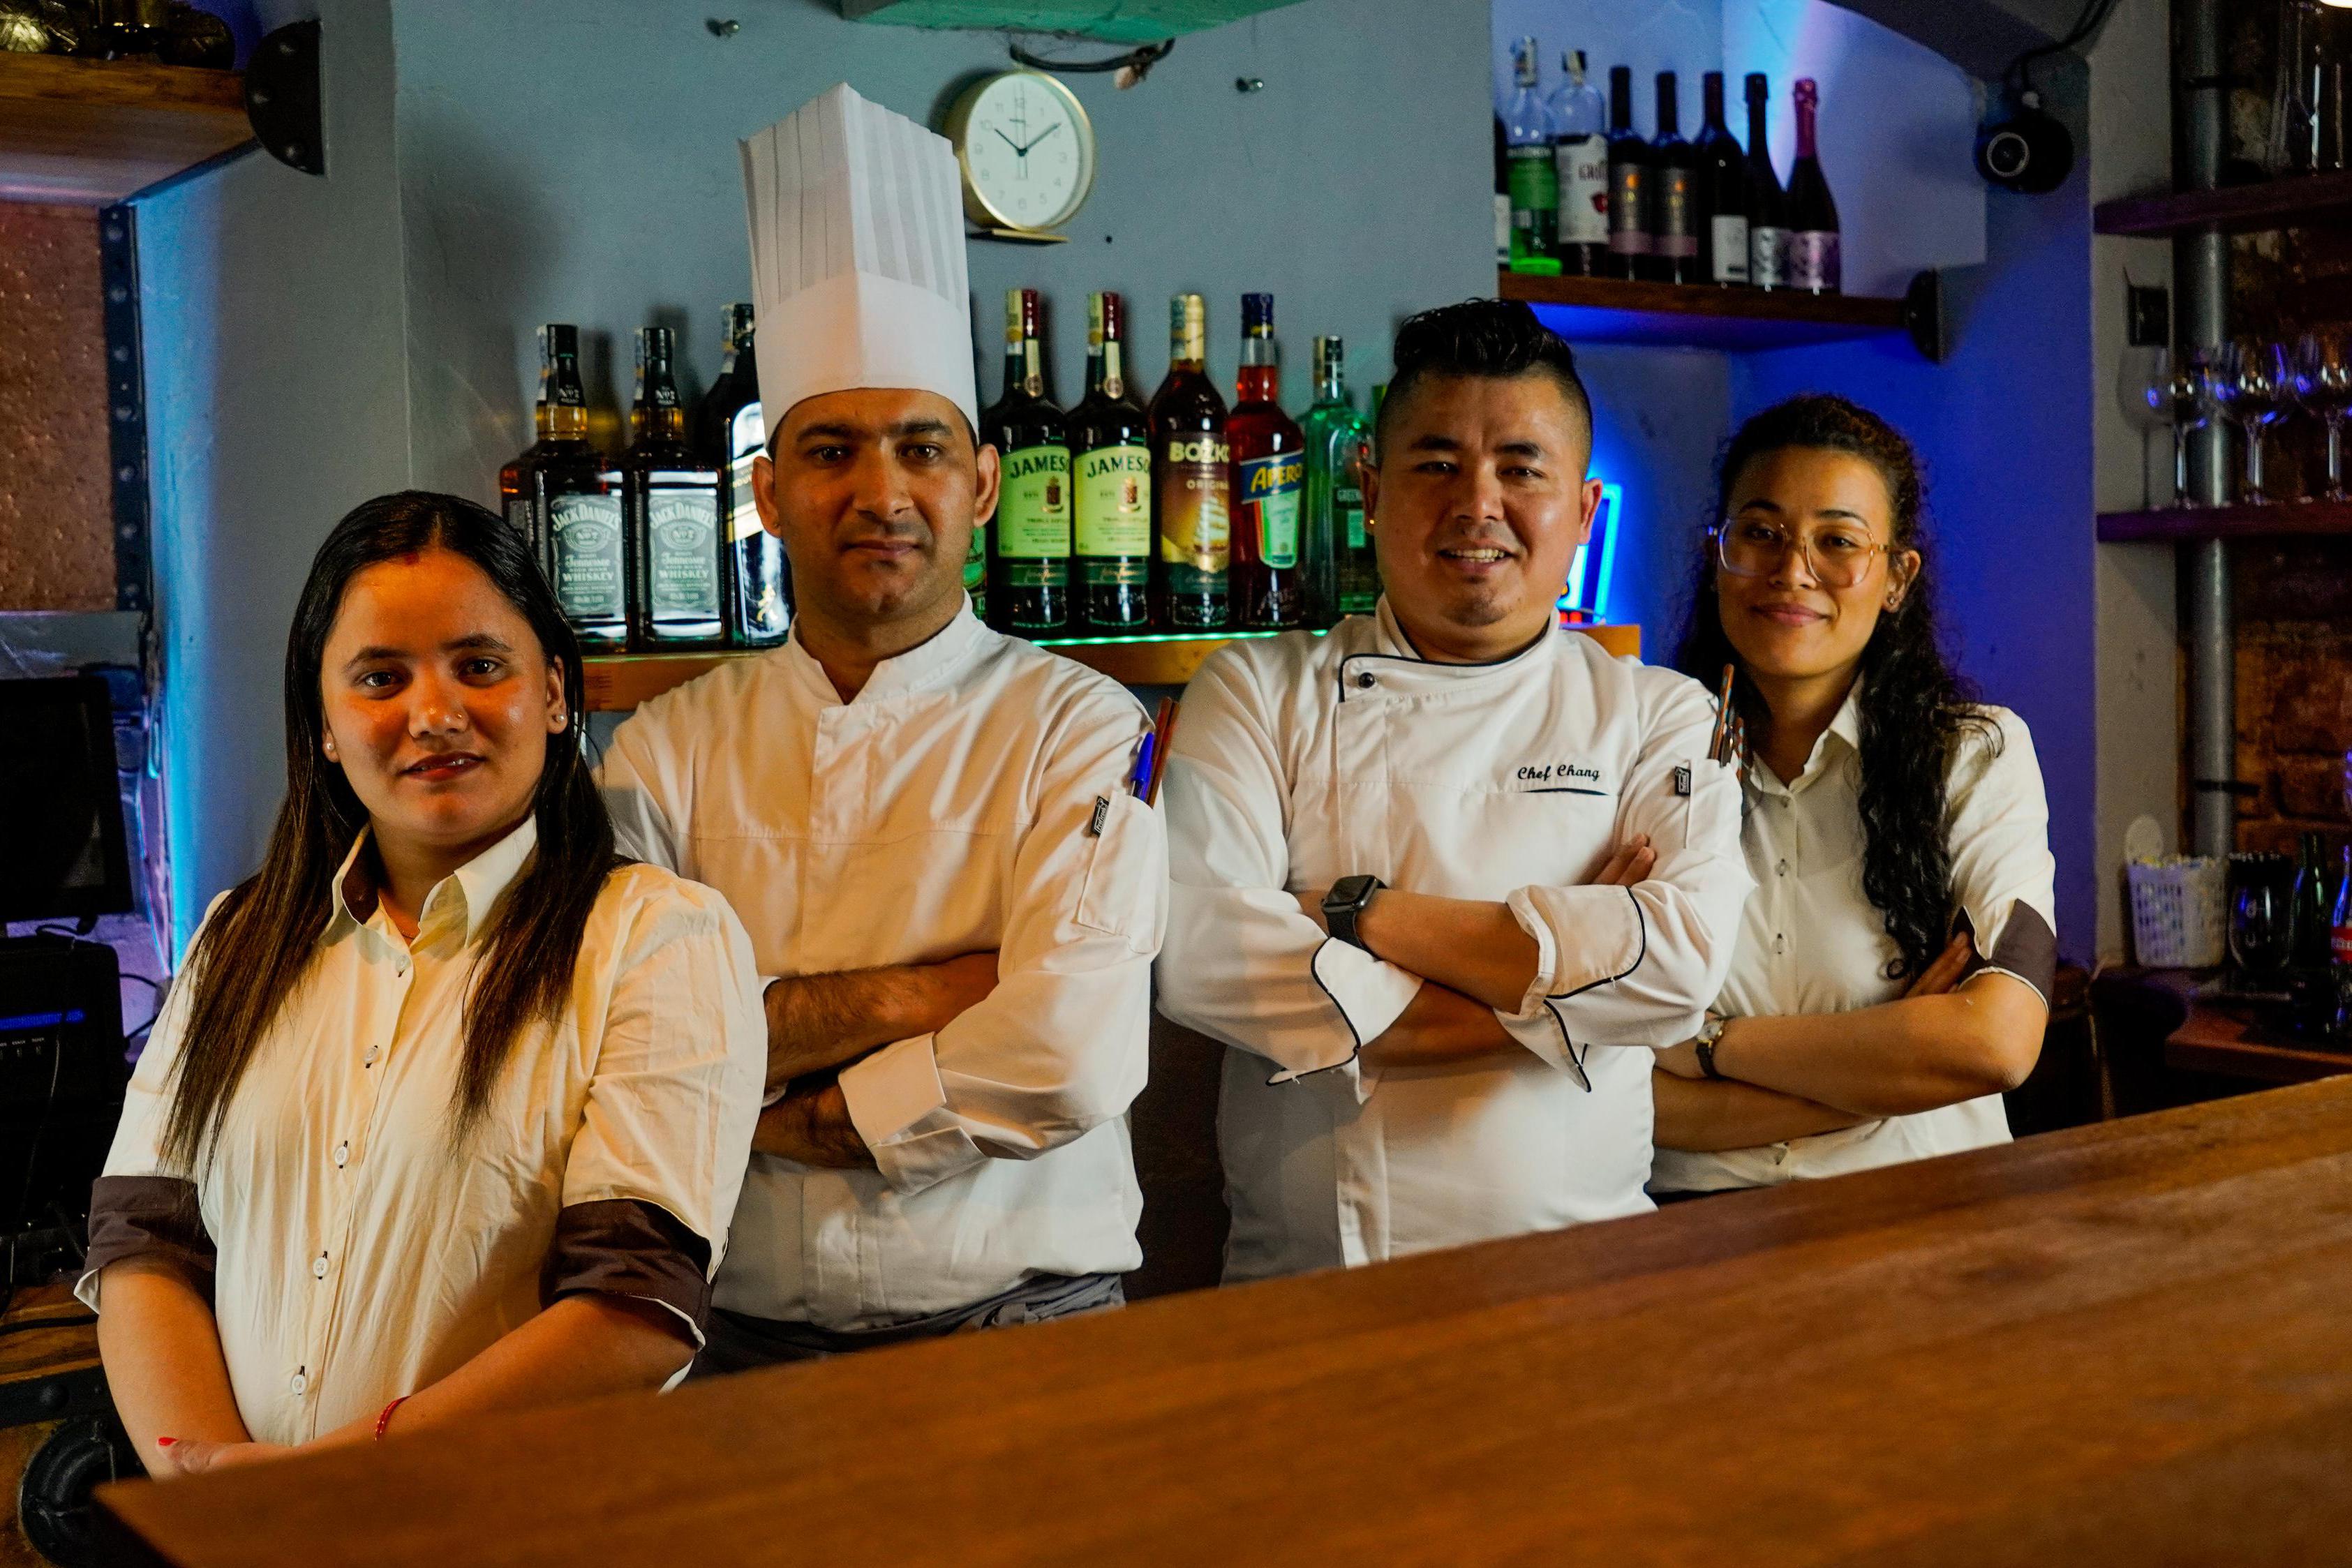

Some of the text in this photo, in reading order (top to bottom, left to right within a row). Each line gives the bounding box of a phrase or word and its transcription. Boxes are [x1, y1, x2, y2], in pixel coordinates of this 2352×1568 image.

[995, 101, 1004, 112] 11
[980, 119, 992, 130] 10
[975, 143, 983, 155] 9
[1059, 151, 1068, 163] 3
[981, 168, 990, 180] 8
[1053, 177, 1062, 187] 4
[998, 190, 1005, 200] 7
[1039, 193, 1048, 204] 5
[1018, 197, 1027, 209] 6
[551, 507, 579, 532] JACK
[648, 506, 676, 530] JACK
[562, 572, 614, 582] WHISKEY
[658, 569, 709, 579] WHISKEY
[1517, 765, 1600, 782] Chef Chang
